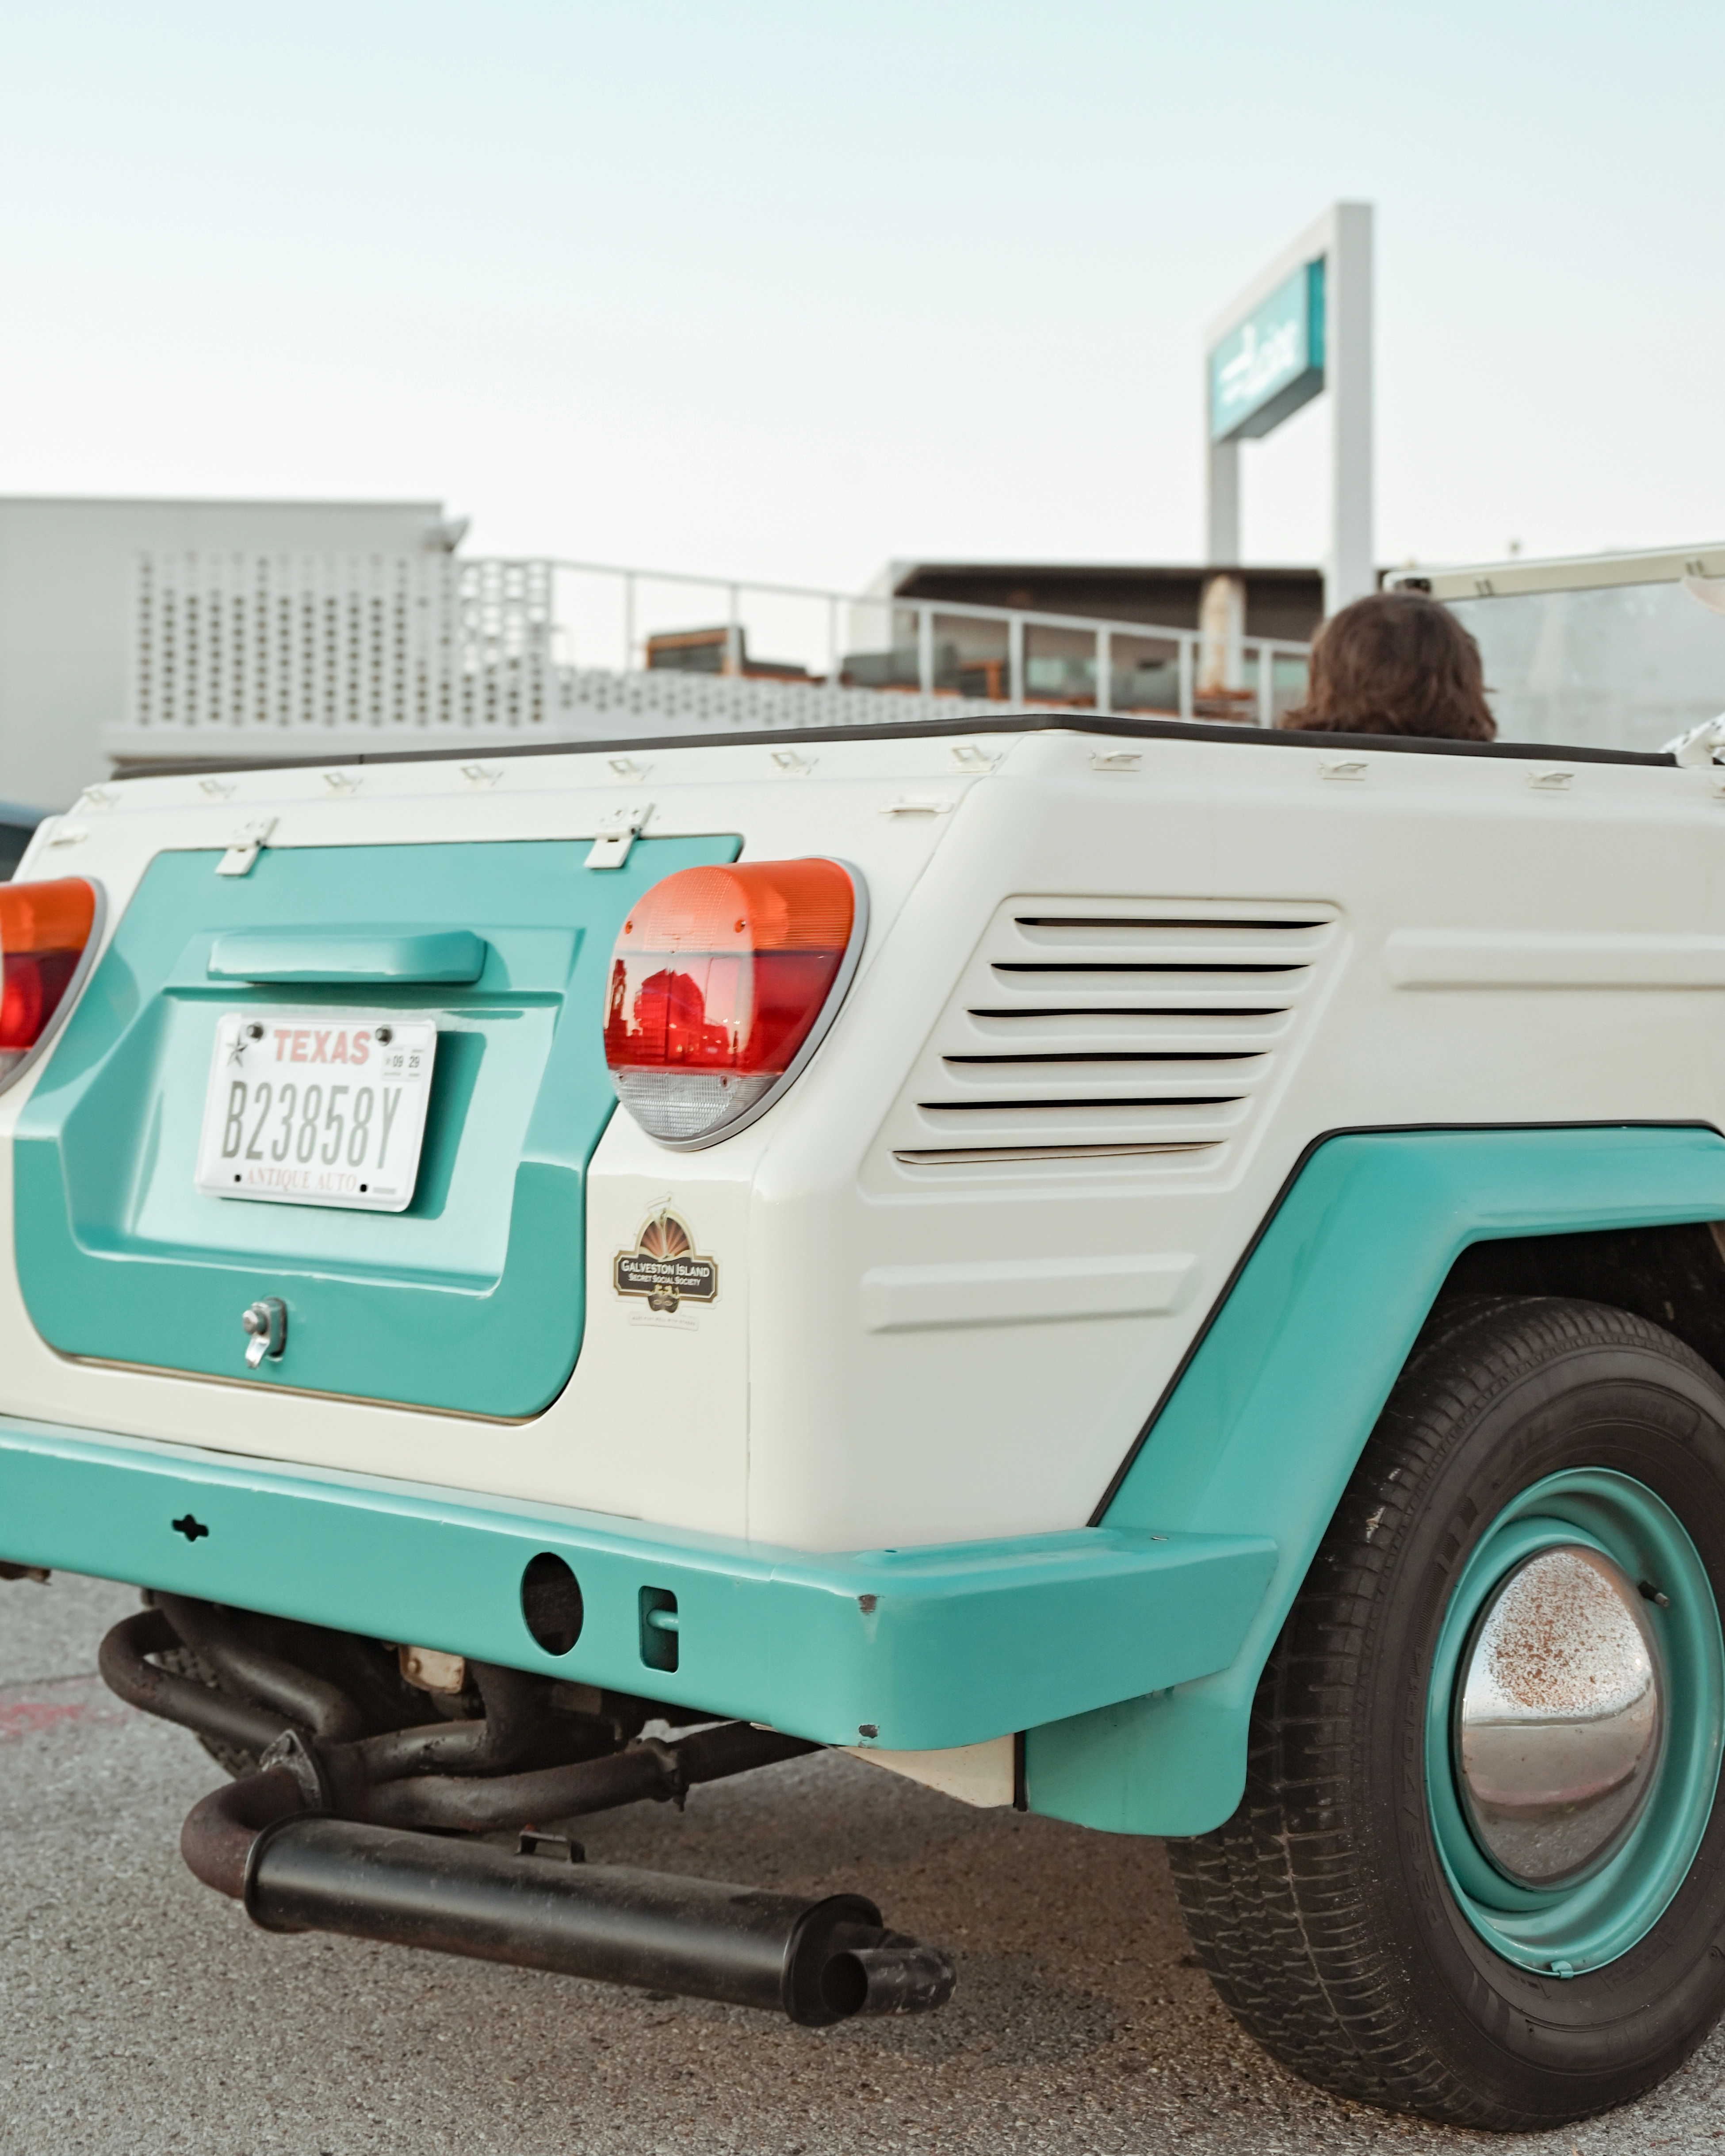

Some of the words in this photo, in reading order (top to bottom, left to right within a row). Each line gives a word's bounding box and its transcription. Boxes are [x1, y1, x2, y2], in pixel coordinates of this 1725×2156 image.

[273, 1029, 371, 1065] TEXAS
[393, 1055, 404, 1067] 09
[409, 1055, 420, 1068] 29
[222, 1080, 402, 1170] B23858Y
[247, 1168, 312, 1191] ANTIQUE
[316, 1173, 357, 1192] AUTO
[620, 1260, 674, 1275] GALVESTON
[675, 1263, 710, 1277] ISLAND
[627, 1273, 652, 1282] SECRET
[652, 1274, 674, 1284] SOCIAL
[674, 1276, 701, 1286] SOCIETY
